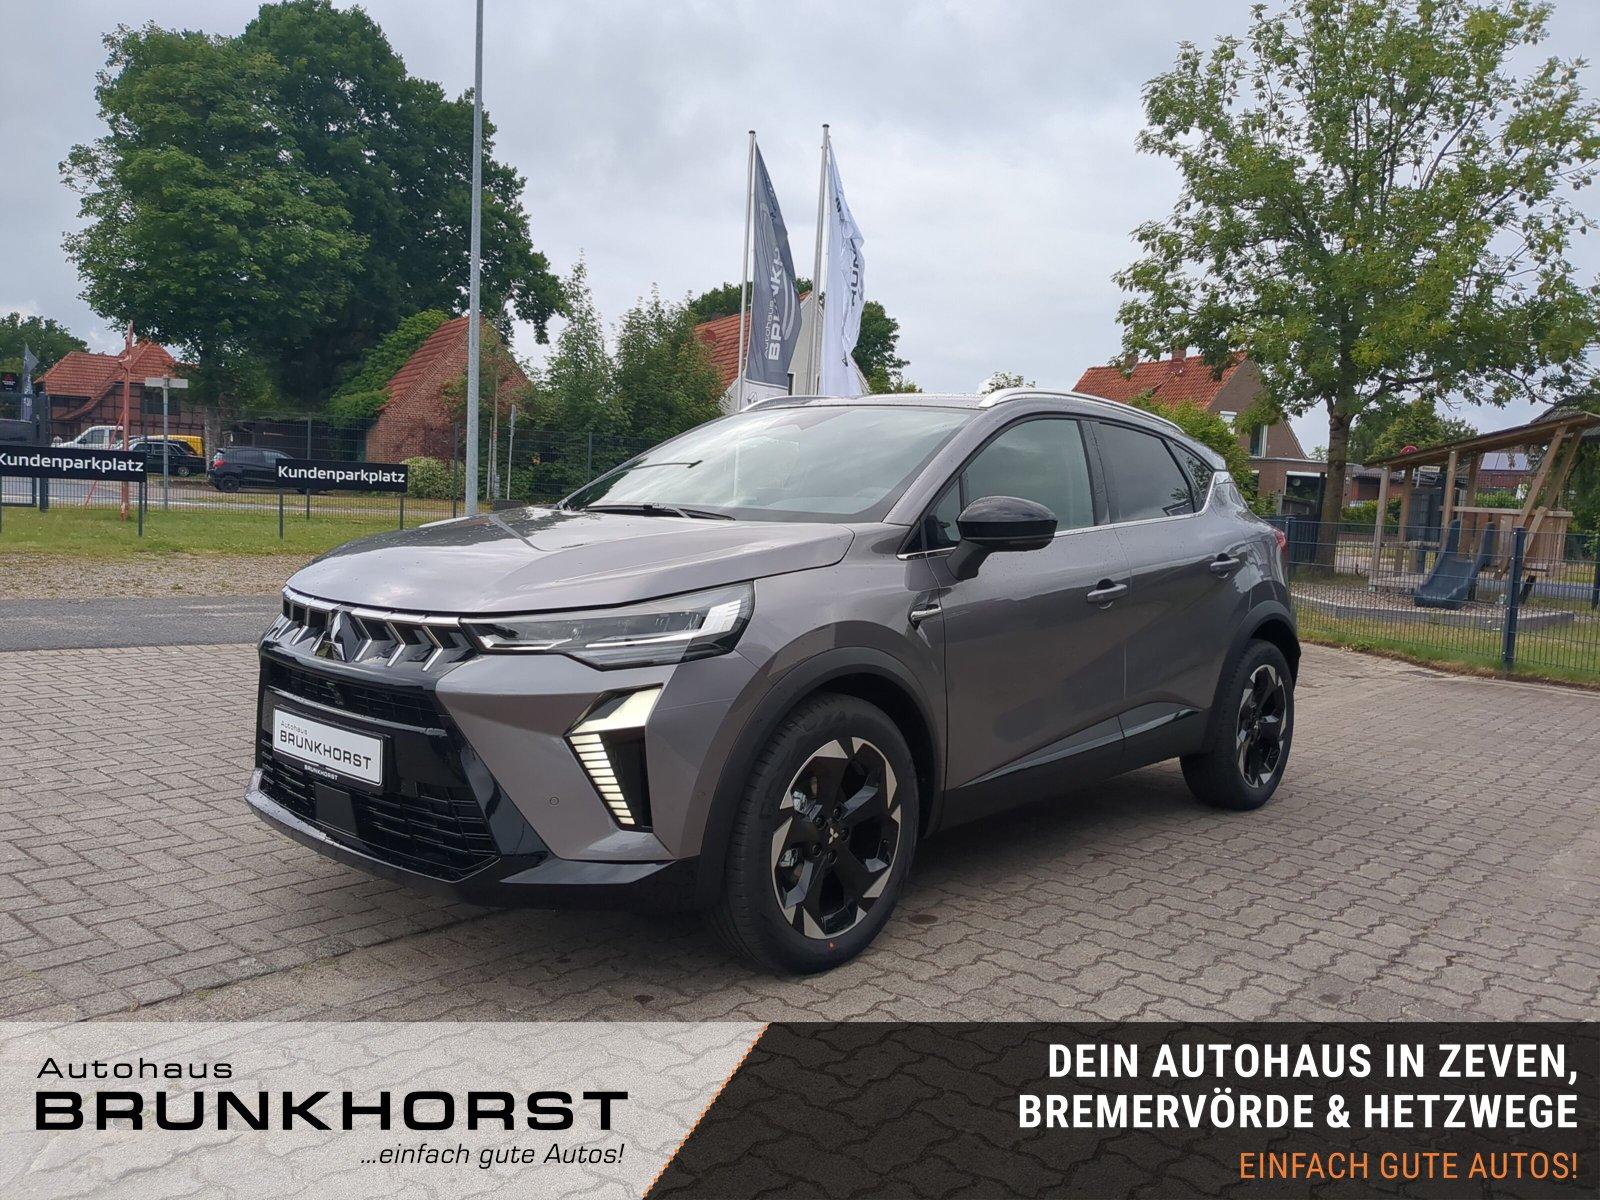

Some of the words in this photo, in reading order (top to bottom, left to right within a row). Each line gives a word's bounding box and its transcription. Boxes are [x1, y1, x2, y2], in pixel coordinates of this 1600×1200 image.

[278, 466, 405, 484] Kundenparkplatz
[281, 721, 308, 735] Autohaus
[280, 730, 372, 770] BRUNKHORST
[304, 764, 338, 780] BRUNKHORST
